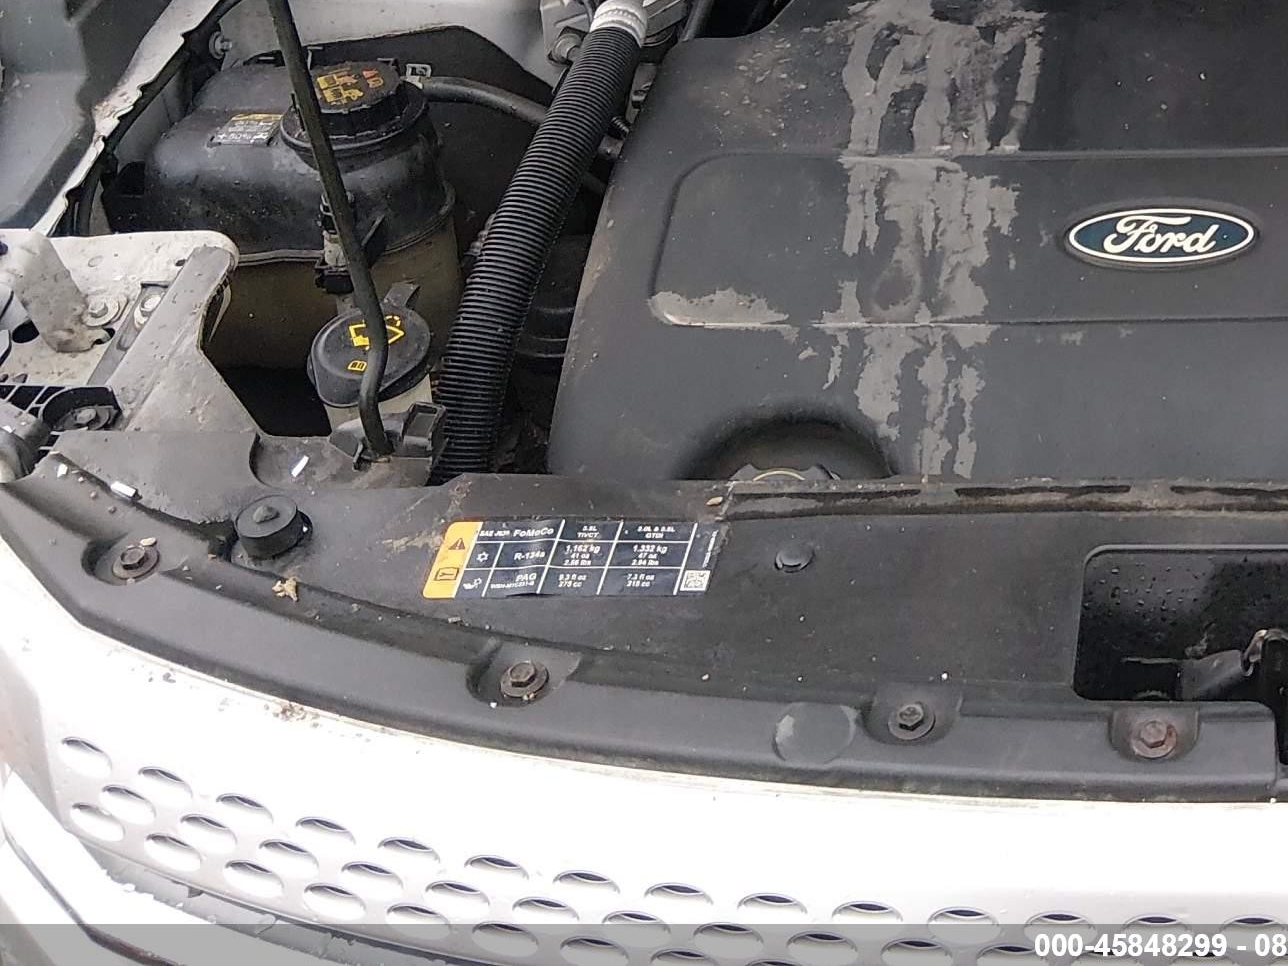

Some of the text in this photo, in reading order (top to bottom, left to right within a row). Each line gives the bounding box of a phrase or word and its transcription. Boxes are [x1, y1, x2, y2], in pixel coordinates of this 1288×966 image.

[1103, 215, 1220, 254] Ford
[513, 527, 554, 537] FoMoCo
[589, 544, 601, 554] kg
[656, 545, 668, 554] kg
[514, 551, 546, 560] R-134a
[515, 573, 537, 582] PAG
